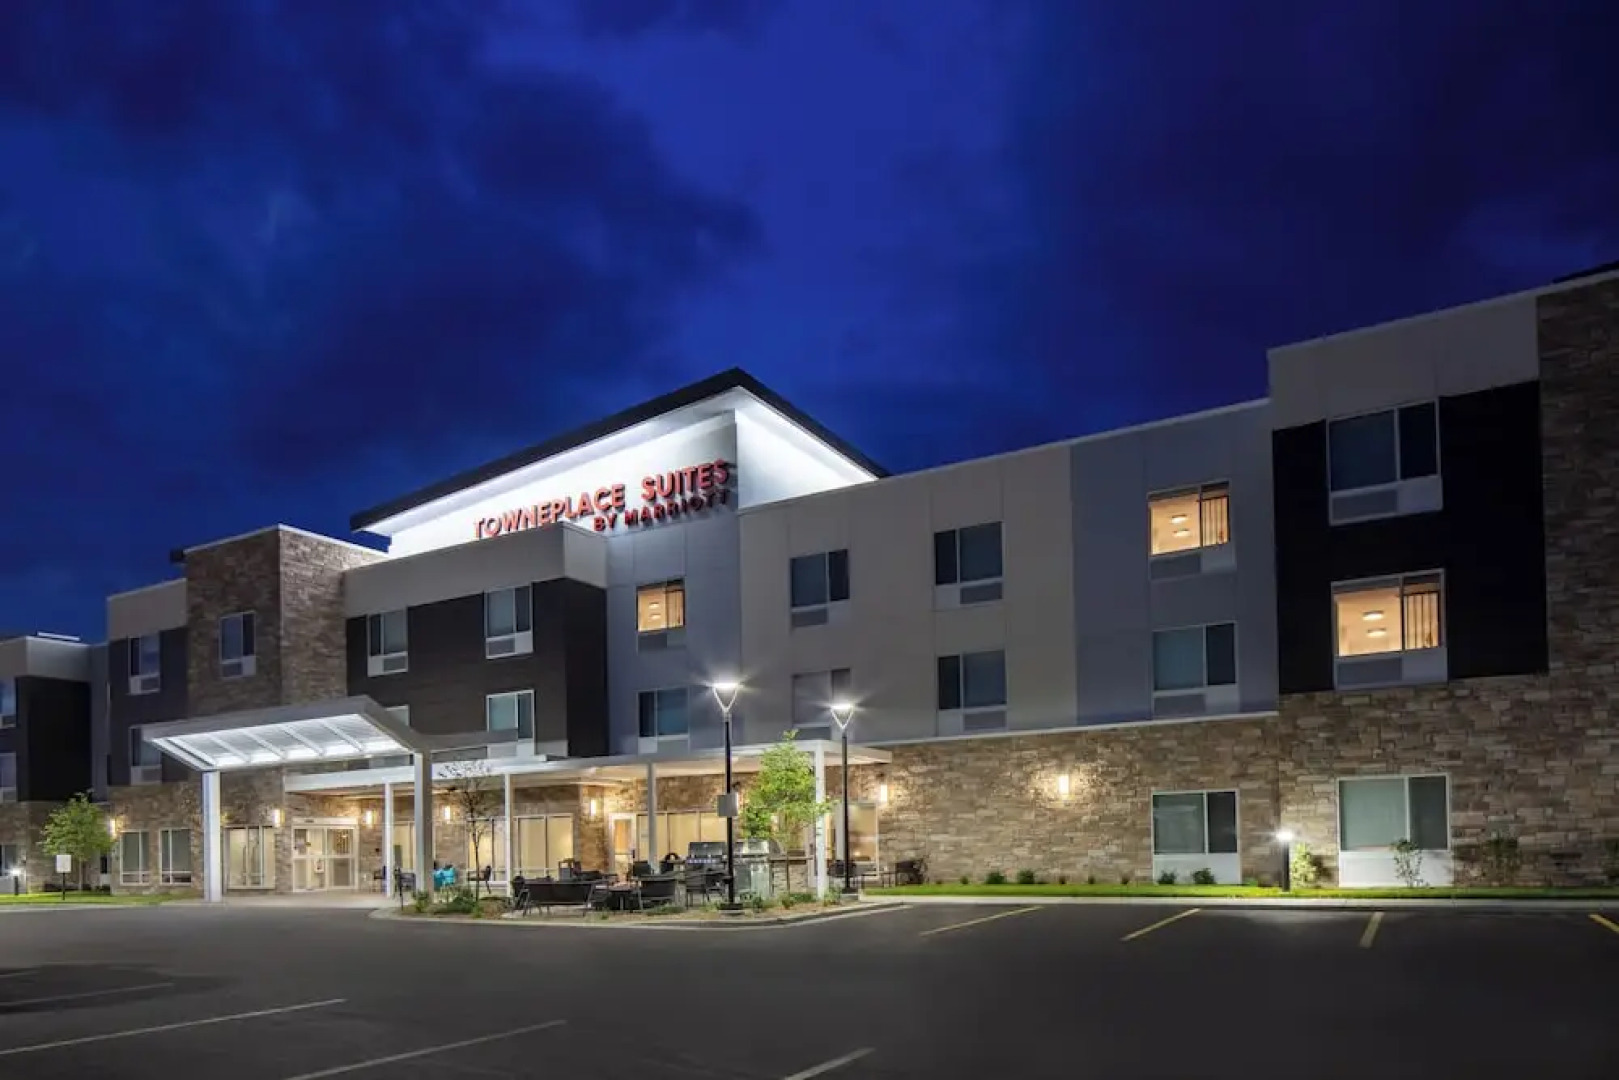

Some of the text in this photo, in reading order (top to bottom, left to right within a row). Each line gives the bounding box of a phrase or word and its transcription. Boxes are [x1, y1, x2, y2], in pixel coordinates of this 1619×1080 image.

[474, 459, 729, 539] TOWNEPLACE SUITES
[593, 489, 730, 532] BY MARRIOTT
